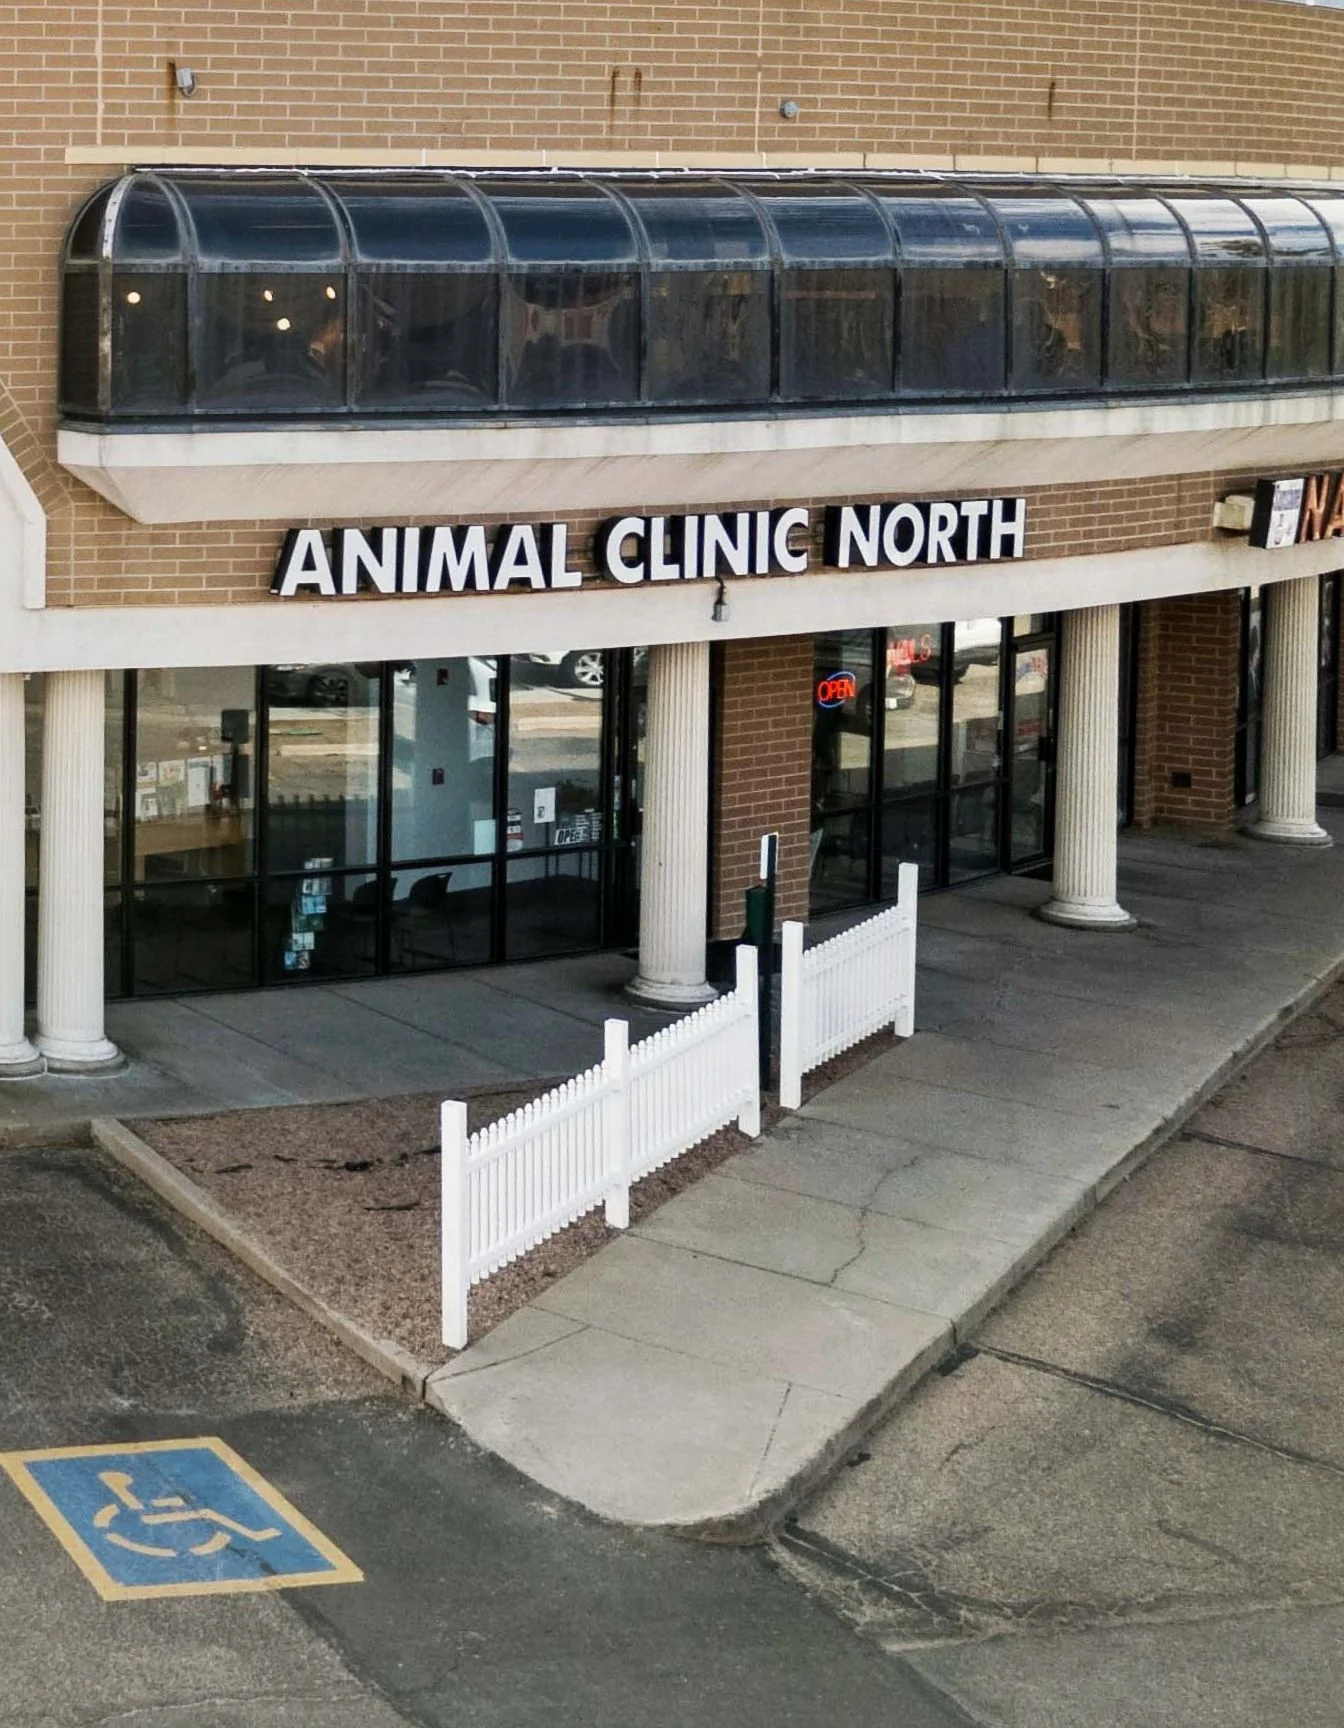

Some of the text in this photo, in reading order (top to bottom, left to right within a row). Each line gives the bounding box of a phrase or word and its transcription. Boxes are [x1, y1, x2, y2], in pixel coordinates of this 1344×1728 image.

[278, 498, 1027, 597] ANIMAL CLINIC NORTH
[818, 679, 857, 702] OPEN
